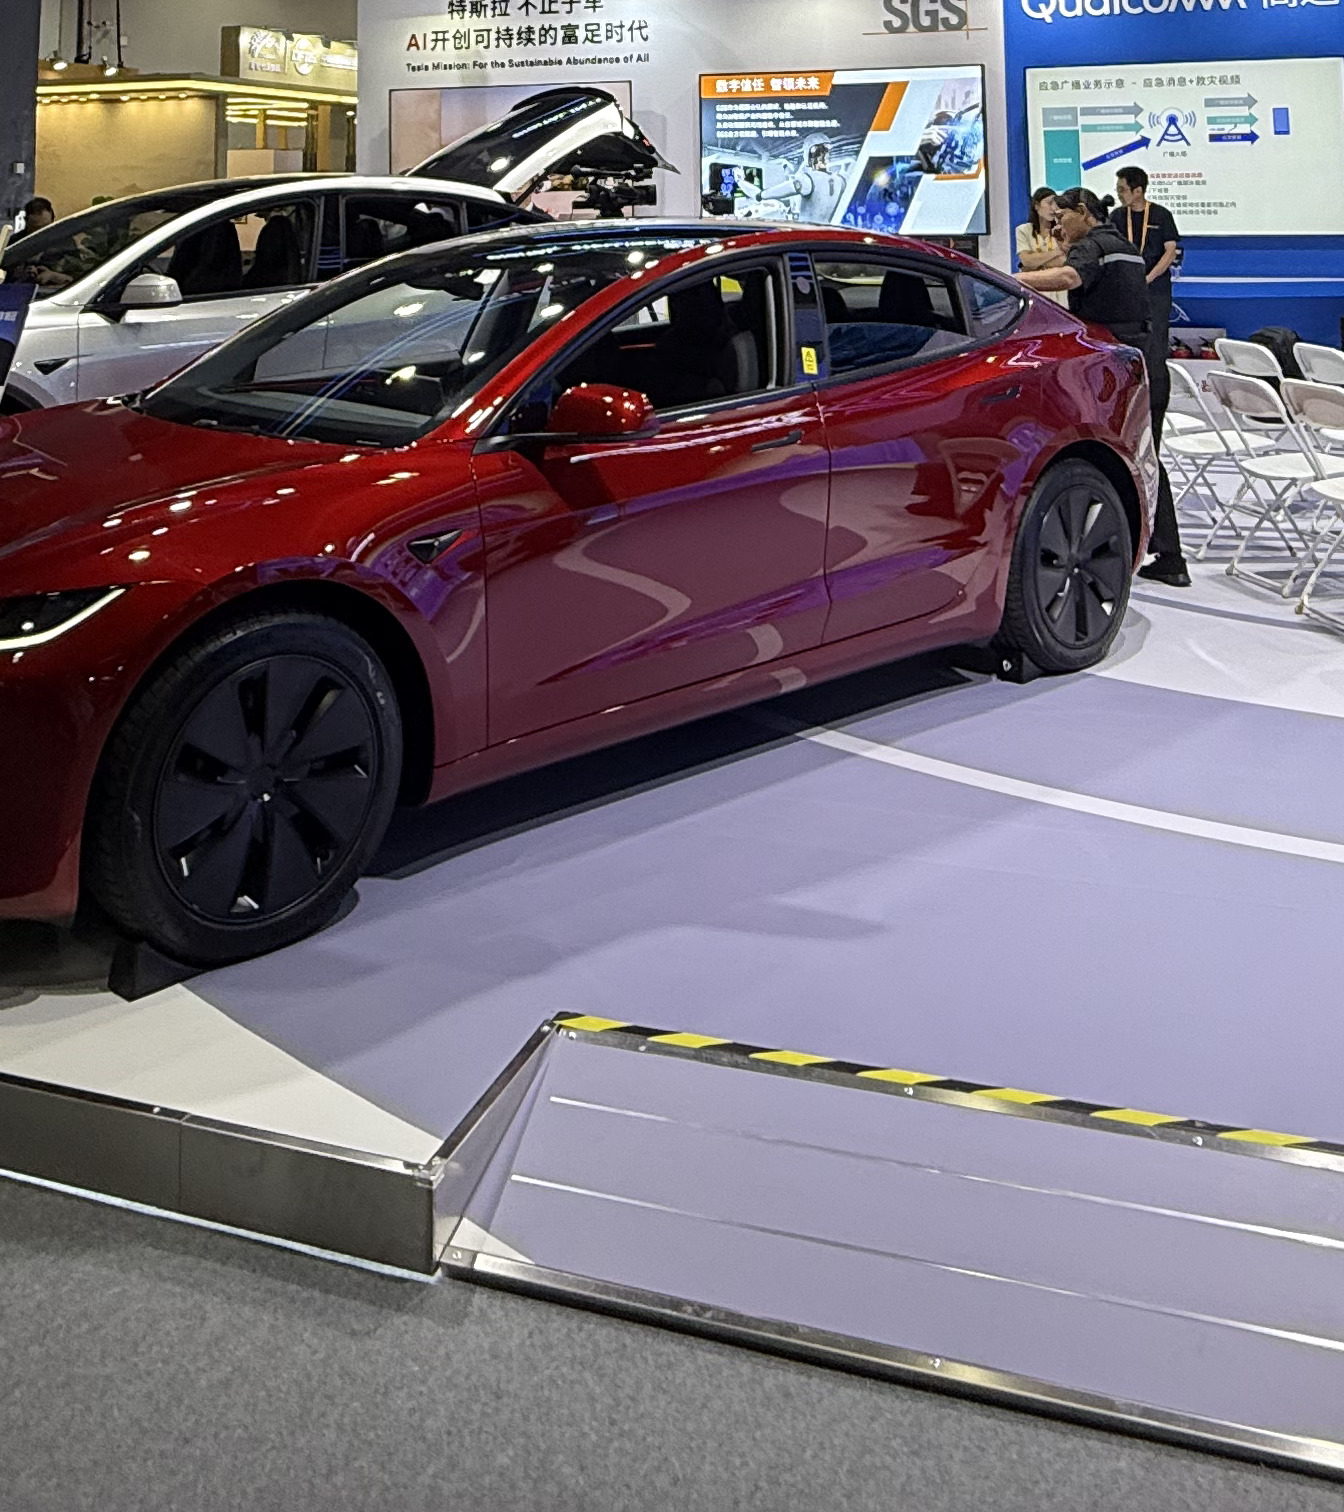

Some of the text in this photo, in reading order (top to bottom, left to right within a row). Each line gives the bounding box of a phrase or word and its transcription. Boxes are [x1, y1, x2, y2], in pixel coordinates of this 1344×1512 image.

[406, 20, 649, 52] AI开创可持续的富足时代
[432, 62, 471, 71] Mission:
[472, 60, 488, 69] For
[491, 60, 505, 68] the
[508, 57, 563, 68] Sustainable
[566, 55, 620, 65] Abundance
[623, 54, 633, 63] of
[636, 53, 649, 63] All
